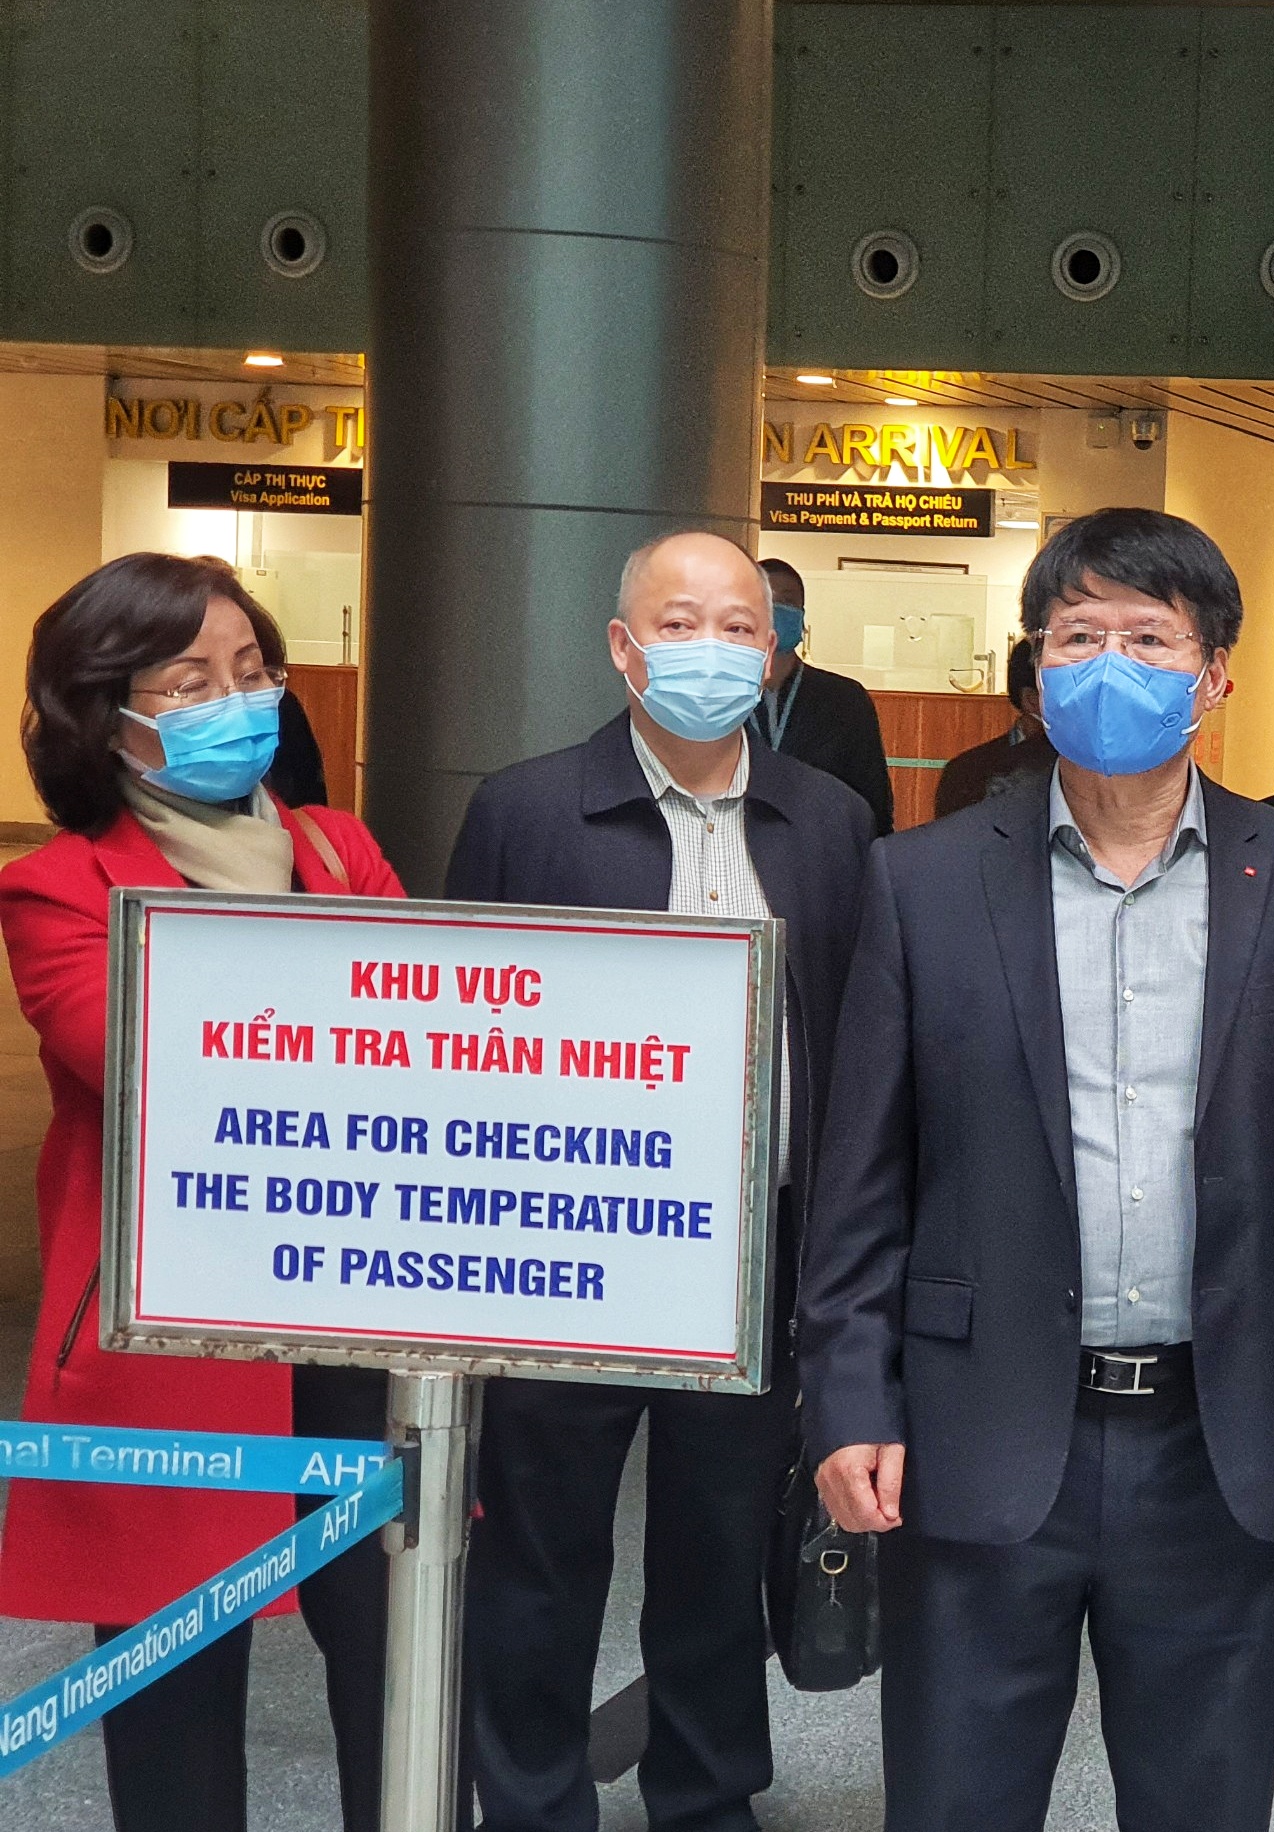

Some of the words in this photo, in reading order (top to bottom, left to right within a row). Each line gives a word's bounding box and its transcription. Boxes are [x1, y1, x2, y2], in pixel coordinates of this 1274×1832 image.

[106, 397, 201, 441] NƠI
[763, 421, 793, 463] N
[803, 423, 1037, 470] ARRIVAL
[231, 490, 257, 503] Visa
[260, 491, 330, 506] Application
[265, 473, 285, 489] THỊ
[785, 492, 813, 506] THU
[816, 490, 840, 507] PHÍ
[842, 491, 862, 507] VÀ
[769, 510, 797, 523] Visa
[800, 511, 857, 527] Payment
[859, 512, 870, 526] &
[872, 512, 931, 529] Passport
[934, 514, 978, 529] Return
[350, 960, 440, 1003] KHU
[455, 964, 542, 1015] VỰC
[202, 1007, 314, 1063] KIỂM
[329, 1027, 411, 1068] TRA
[425, 1026, 543, 1075] THÂN
[559, 1034, 691, 1090] NHIỆT
[214, 1107, 331, 1150] AREA
[346, 1114, 429, 1156] FOR
[444, 1119, 673, 1170] CHECKING
[171, 1170, 250, 1212] THE
[265, 1176, 380, 1219] BODY
[394, 1183, 714, 1240] TEMPERATURE
[272, 1243, 326, 1284] OF
[340, 1248, 605, 1301] PASSENGER
[62, 1435, 243, 1480] Terminal
[63, 1594, 204, 1718] International
[209, 1535, 297, 1621] Terminal
[320, 1490, 364, 1551] AHT
